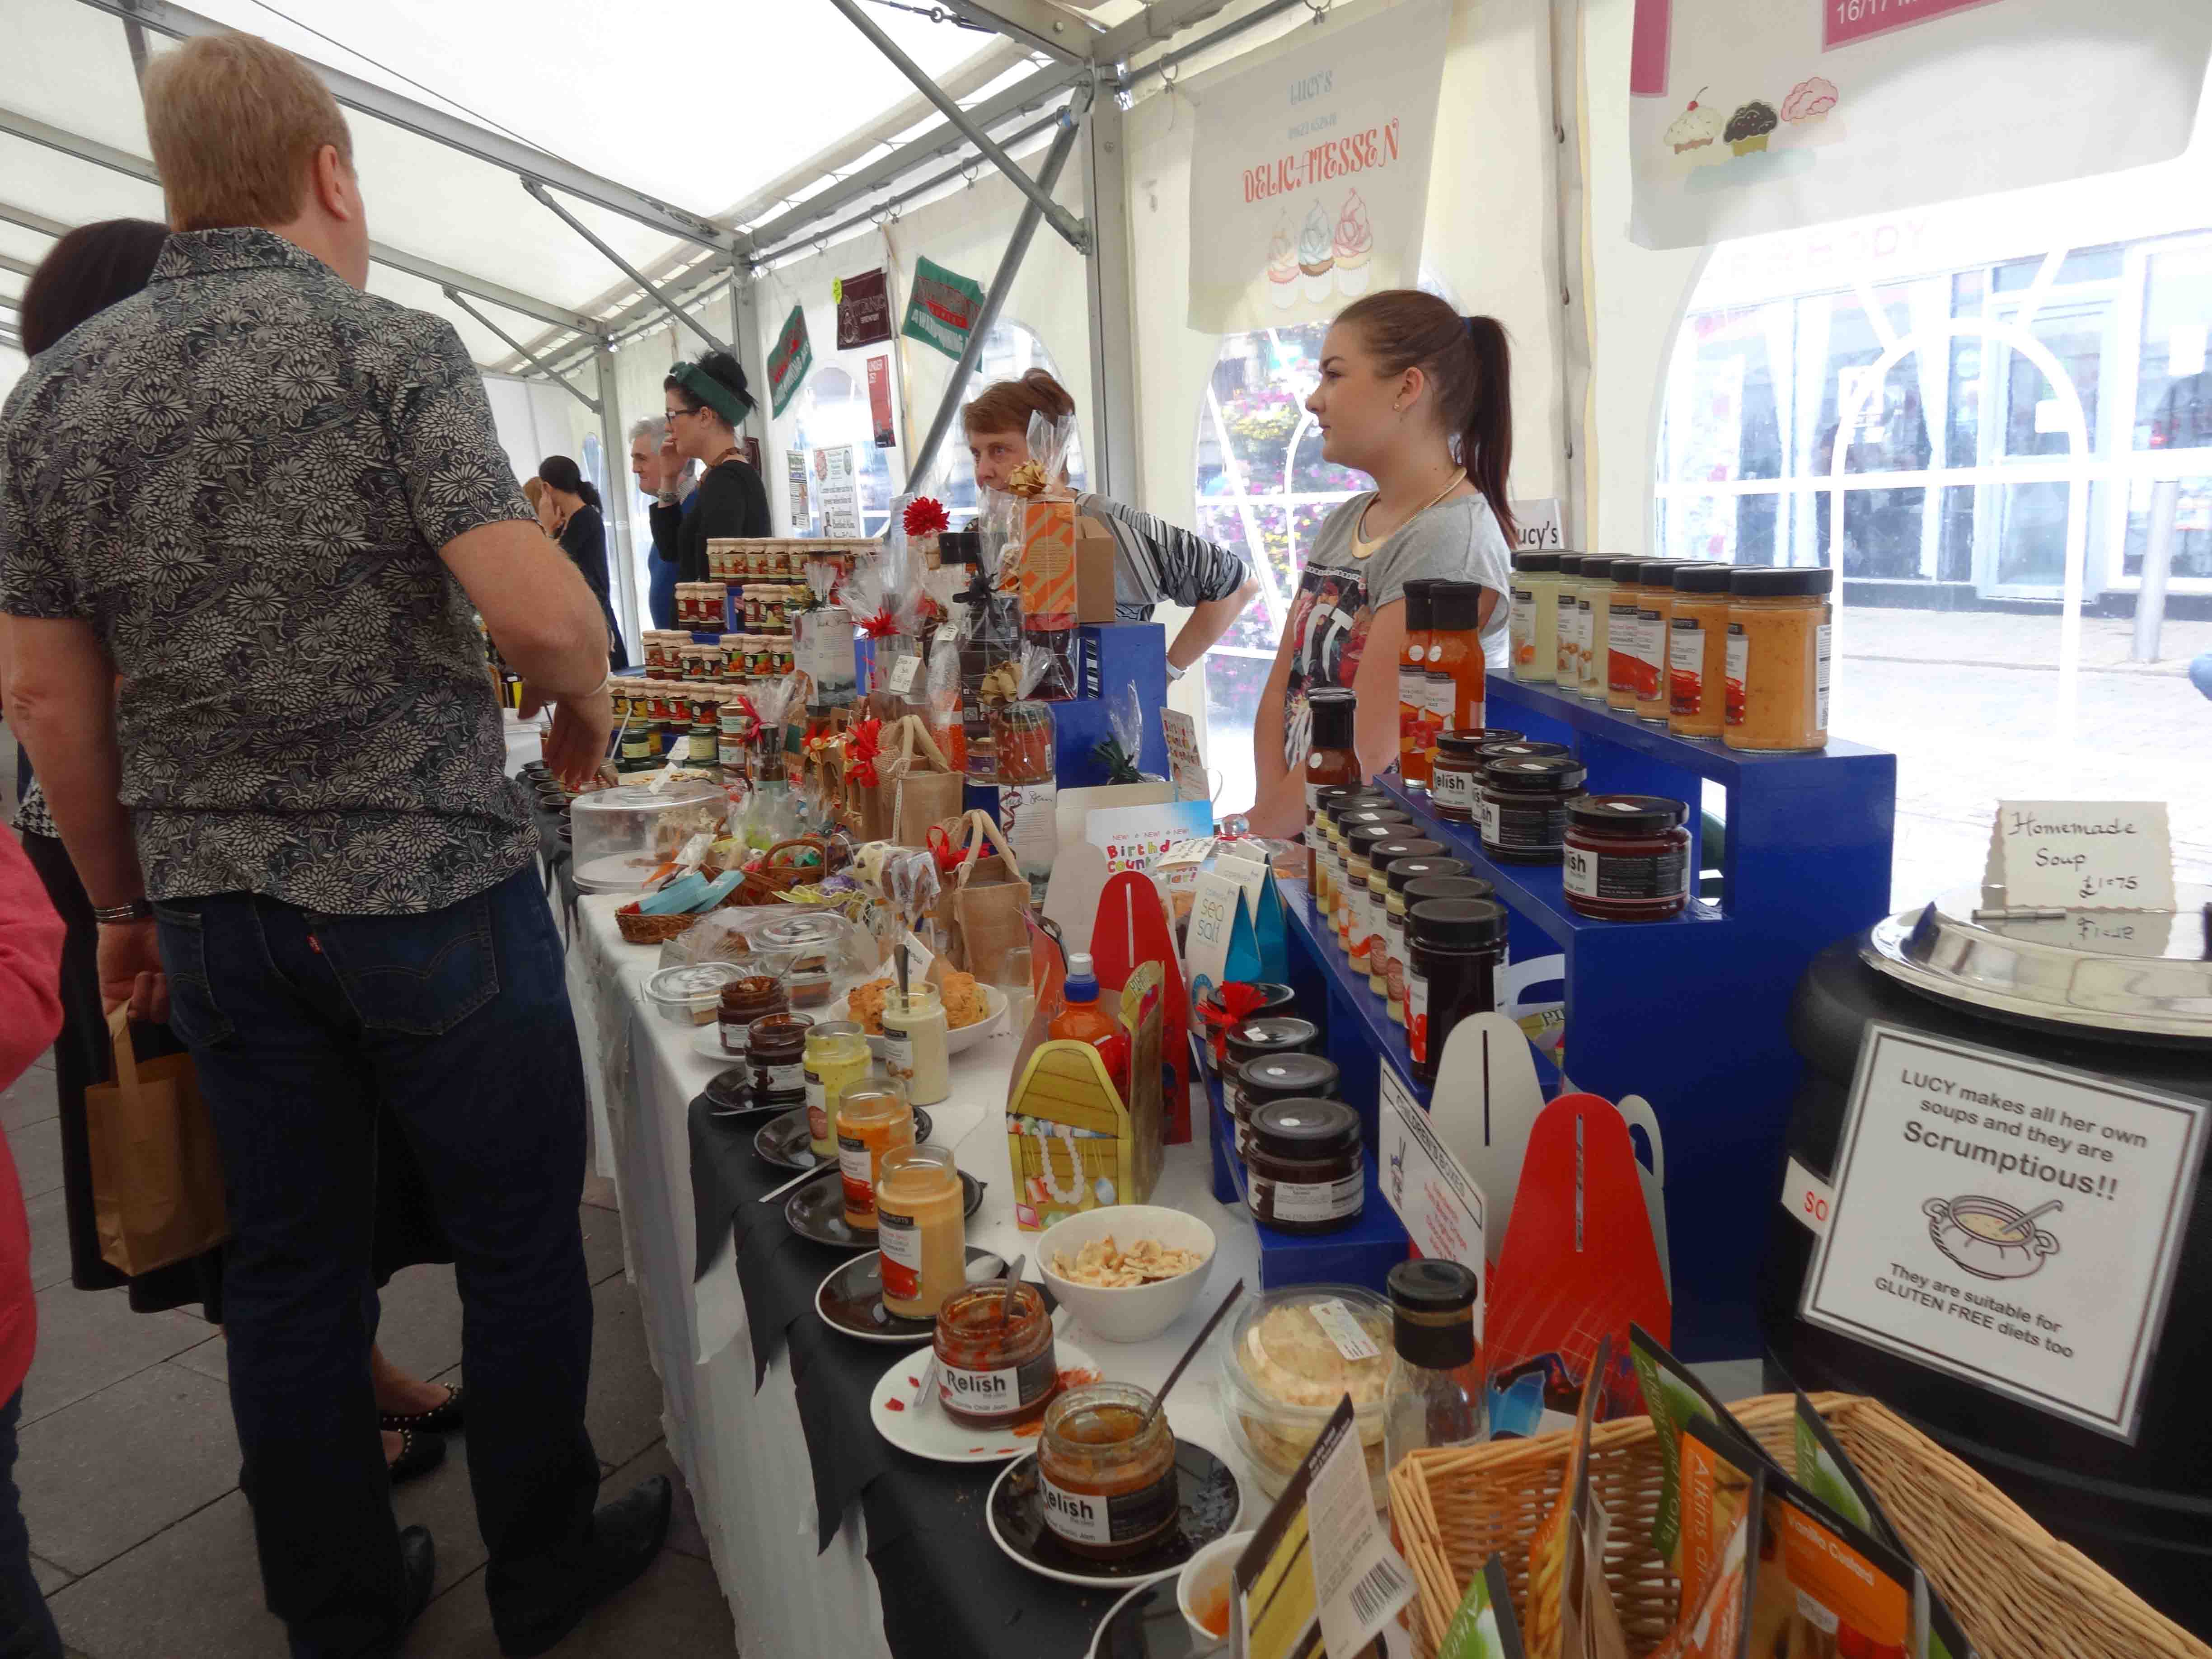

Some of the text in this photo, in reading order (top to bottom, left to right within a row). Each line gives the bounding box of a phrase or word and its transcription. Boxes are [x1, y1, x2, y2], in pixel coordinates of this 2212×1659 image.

[1243, 116, 1399, 202] DELICATESSEN
[1518, 520, 1557, 550] ucy's
[2008, 812, 2137, 836] Homemade
[1107, 839, 1182, 859] Birthd
[2035, 848, 2088, 872] Soup
[1197, 919, 1219, 944] salt
[1201, 899, 1224, 922] sea
[1901, 1068, 2147, 1149] LUCY makes all her own
[1921, 1098, 2114, 1162] soups and they are
[1903, 1120, 2119, 1202] Scrumptious!!
[1875, 1277, 2074, 1359] GLUTEN FREE diets too
[1890, 1263, 2062, 1334] They are suitable for
[947, 1369, 1006, 1395] Relish
[1694, 1454, 1711, 1537] Atkins
